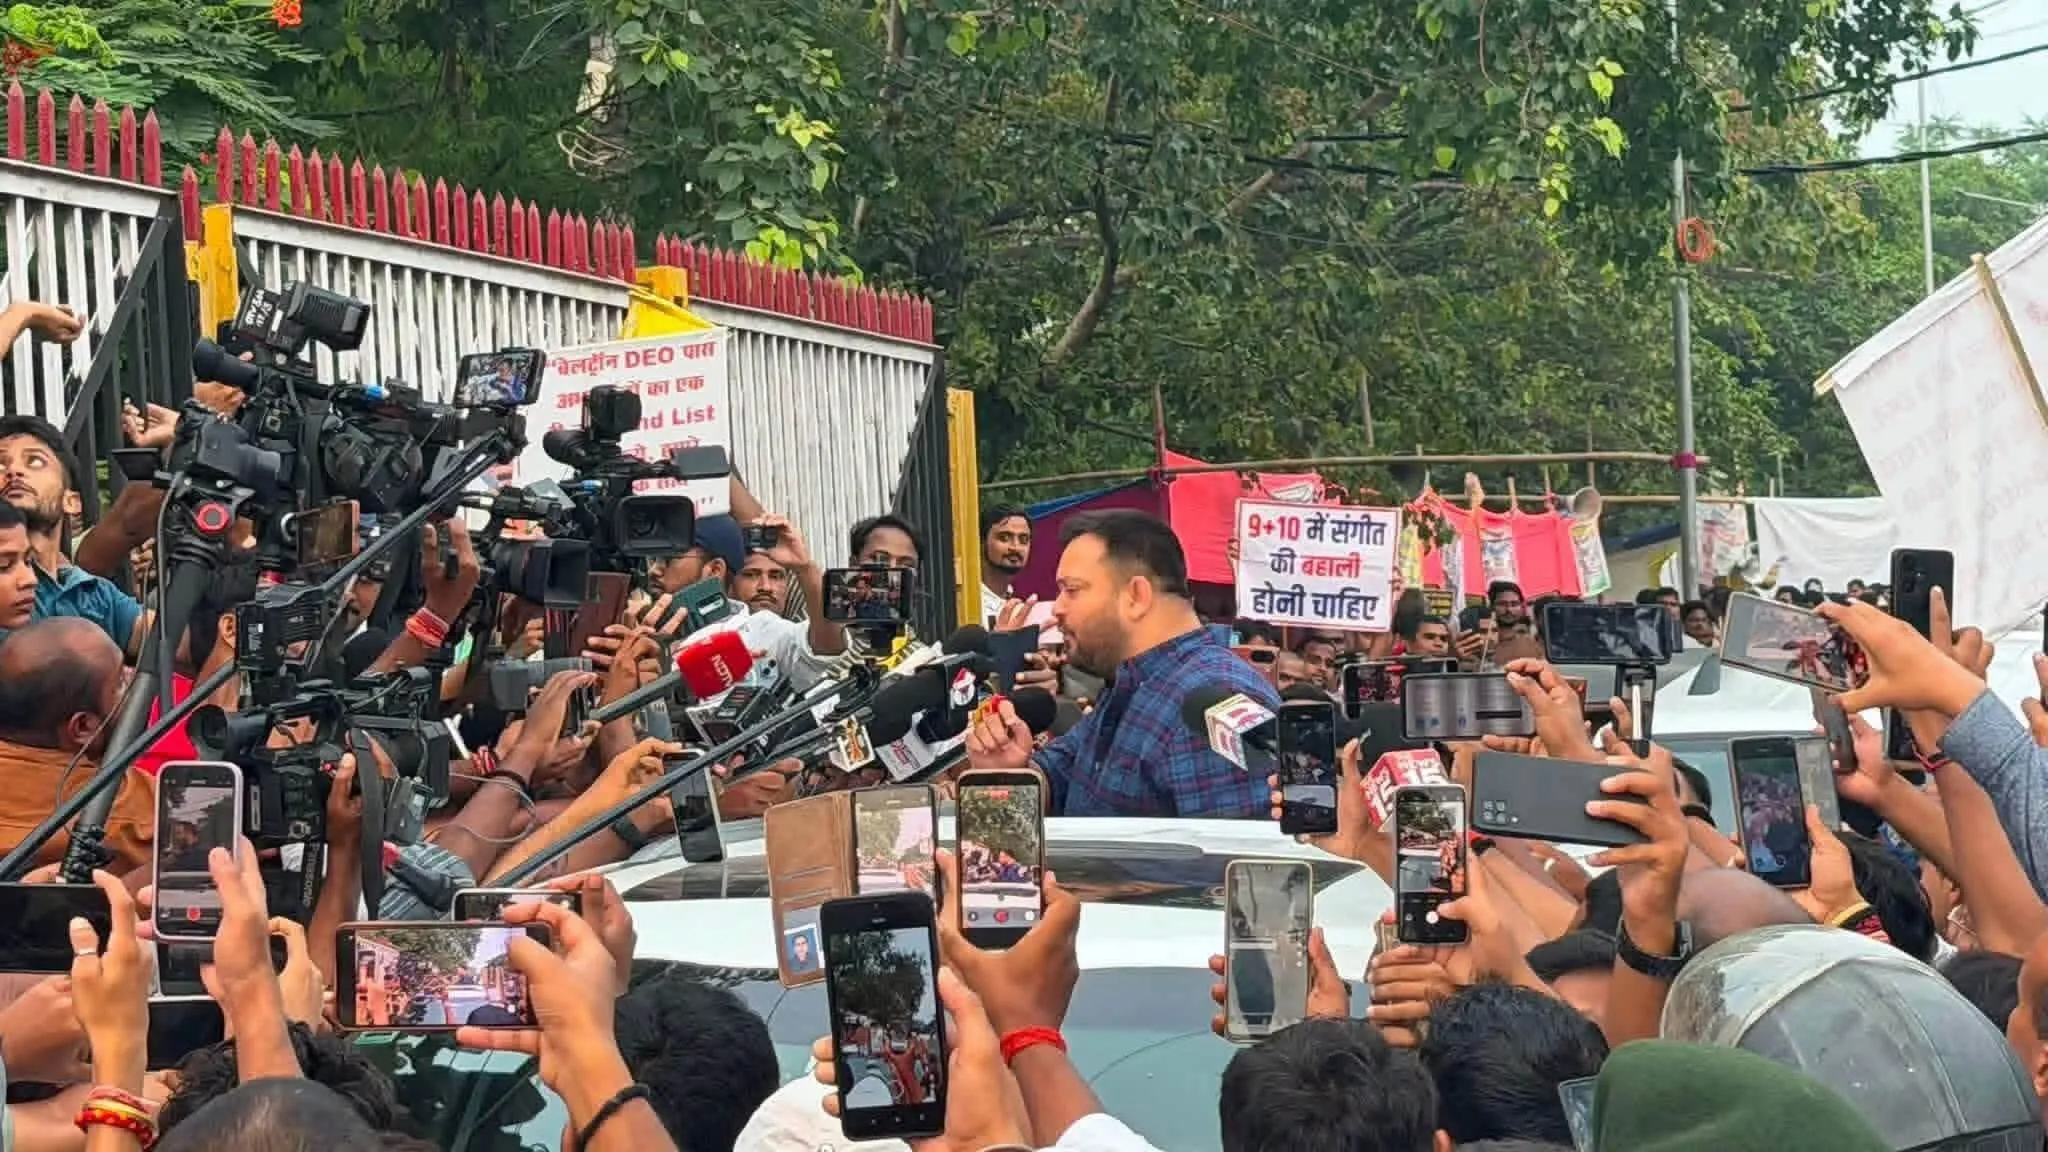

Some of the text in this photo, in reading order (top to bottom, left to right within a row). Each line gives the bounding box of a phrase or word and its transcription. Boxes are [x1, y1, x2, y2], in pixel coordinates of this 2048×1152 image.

[624, 346, 674, 368] DEO
[646, 380, 670, 396] का
[676, 375, 705, 392] एक
[672, 404, 716, 426] List
[1248, 512, 1388, 546] 9+10 में संगीत
[1269, 547, 1297, 574] की
[1251, 581, 1379, 620] होनी चाहिए
